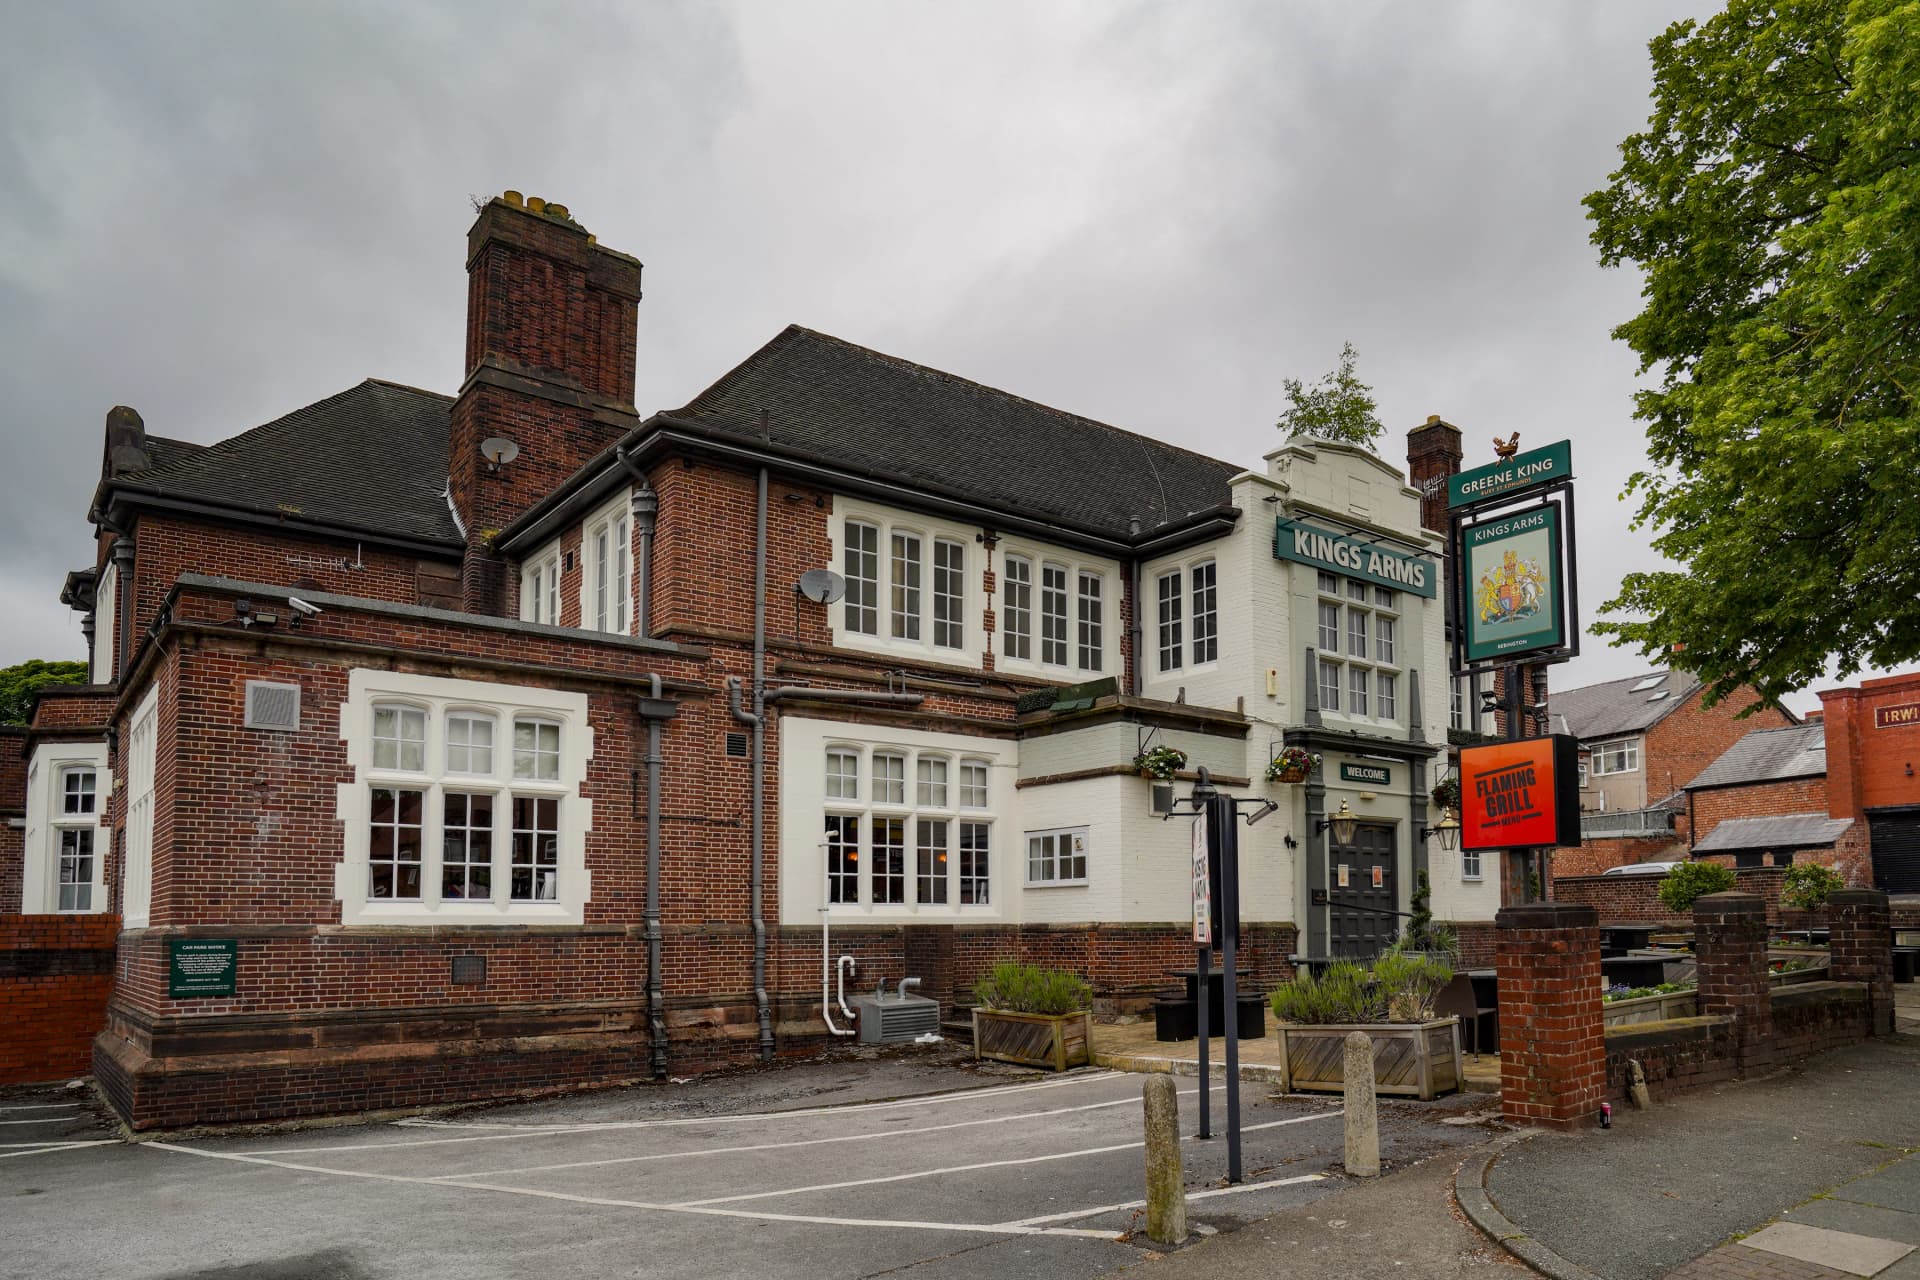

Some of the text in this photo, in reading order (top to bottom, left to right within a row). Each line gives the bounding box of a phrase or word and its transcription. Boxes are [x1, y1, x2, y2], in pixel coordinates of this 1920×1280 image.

[1461, 458, 1553, 494] GREENE KING
[1504, 478, 1531, 489] EDMUNDS
[1475, 514, 1544, 541] KINGS ARMS
[1294, 528, 1425, 588] KINGS ARMS
[1346, 766, 1385, 780] WELCOME
[1476, 768, 1536, 798] FLAMING
[1486, 788, 1534, 818] GRILL
